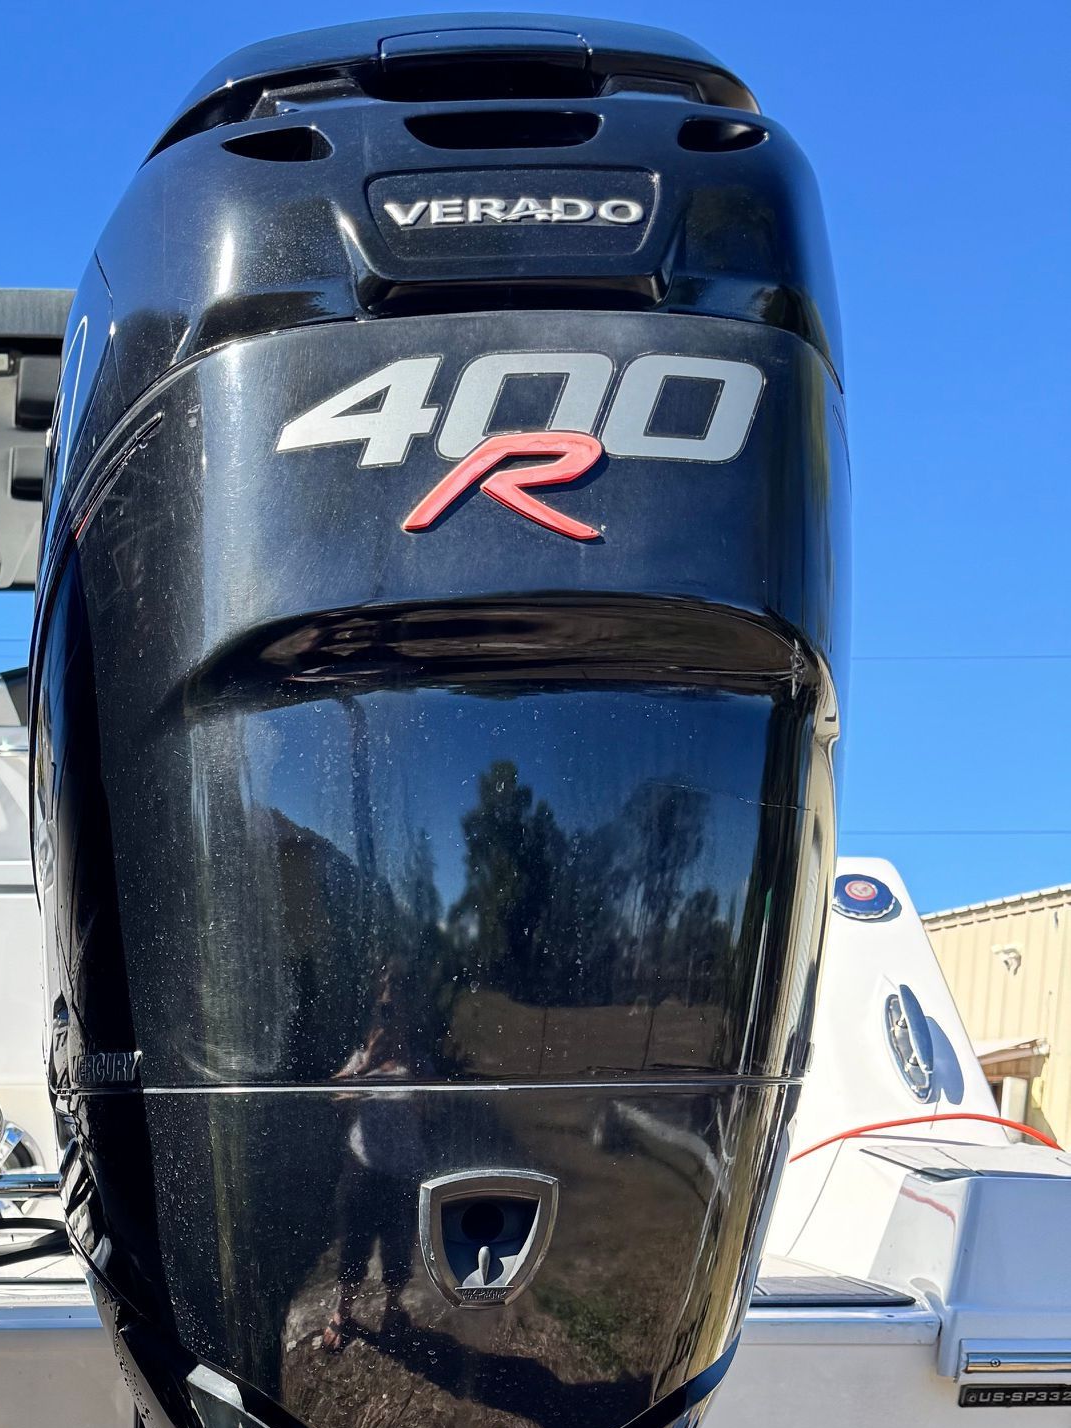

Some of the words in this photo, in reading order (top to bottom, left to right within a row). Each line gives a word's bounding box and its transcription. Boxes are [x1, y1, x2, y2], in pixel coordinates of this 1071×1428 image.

[383, 197, 645, 226] VERADO
[275, 350, 767, 468] 400
[402, 431, 603, 540] R
